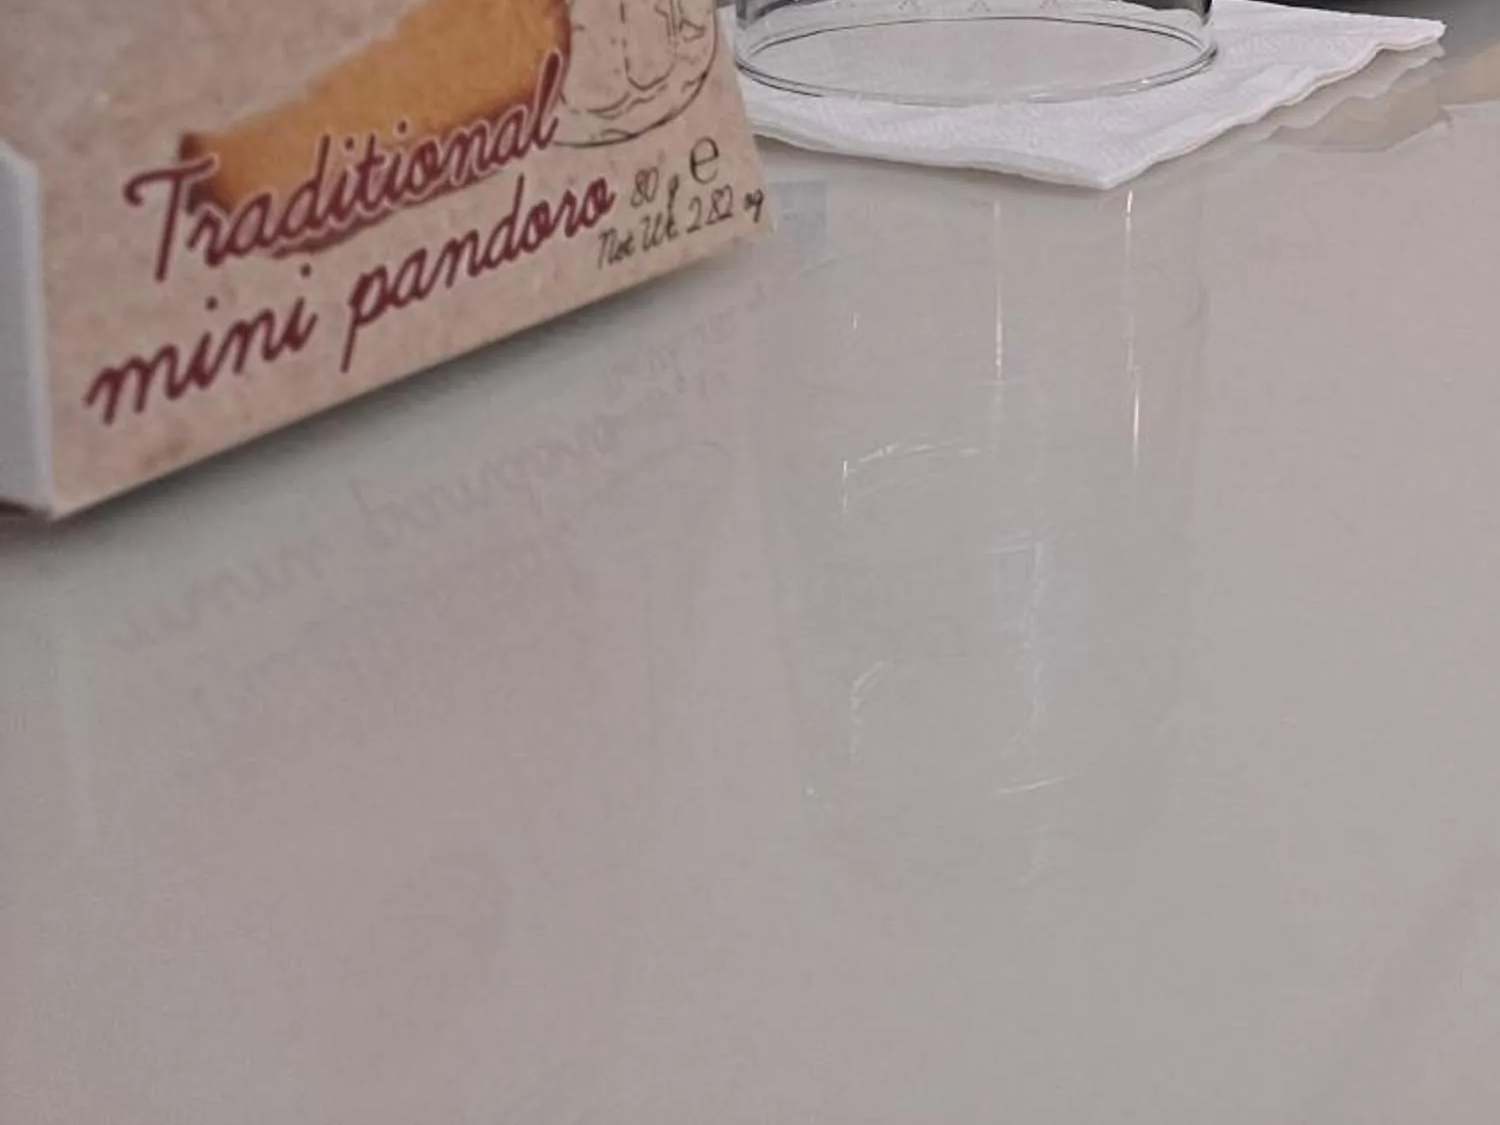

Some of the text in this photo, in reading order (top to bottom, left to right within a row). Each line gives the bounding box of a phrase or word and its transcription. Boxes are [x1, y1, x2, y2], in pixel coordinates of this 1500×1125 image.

[123, 48, 563, 283] Traditional
[84, 176, 617, 426] mini pandoro
